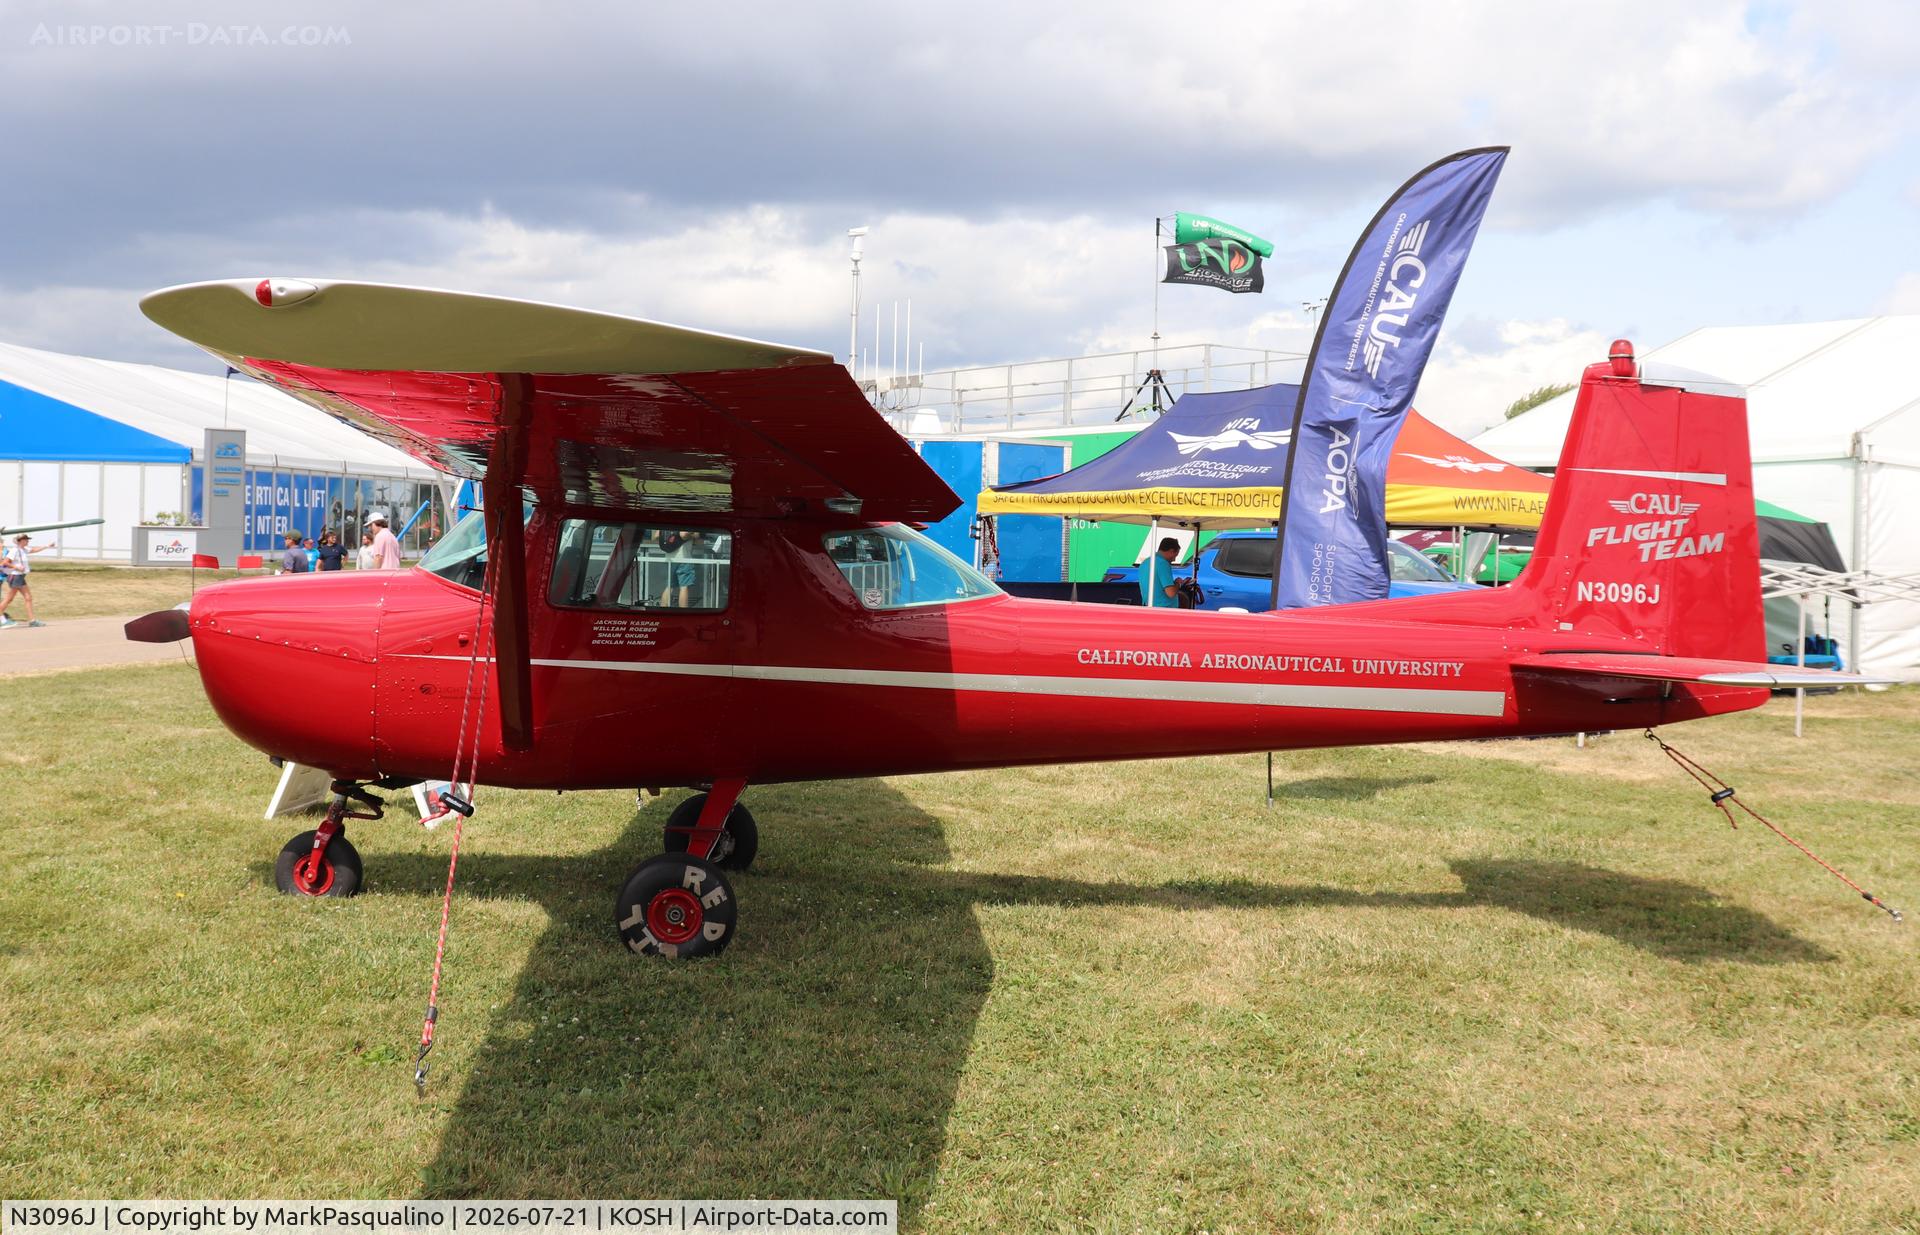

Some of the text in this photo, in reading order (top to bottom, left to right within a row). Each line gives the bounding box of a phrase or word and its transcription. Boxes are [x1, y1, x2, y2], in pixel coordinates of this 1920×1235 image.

[1176, 240, 1255, 275] UND
[1344, 212, 1407, 372] CALIFORNIA AERONAUTICAL UNIVERSITY
[1370, 255, 1426, 348] CAU
[1221, 418, 1261, 432] NIFA
[1320, 425, 1351, 514] AOPA
[245, 485, 326, 508] ERTICAL LIFT
[1139, 491, 1207, 507] EXCELLENCE
[1210, 492, 1269, 508] THROUGH
[1453, 495, 1547, 515] WWW.NIFA.AE
[1629, 492, 1682, 516] CAU
[244, 515, 288, 535] ENTER
[1586, 518, 1690, 548] FLIGHT
[155, 544, 189, 555] Piper
[1637, 532, 1725, 563] TEAM
[1308, 543, 1323, 601] SPONSOR
[1321, 544, 1337, 606] SUPPORTI
[1577, 581, 1660, 605] N3096J
[1077, 648, 1464, 678] CALIFORNIA AERONAUTICAL UNIVERSITY
[682, 865, 728, 942] RED
